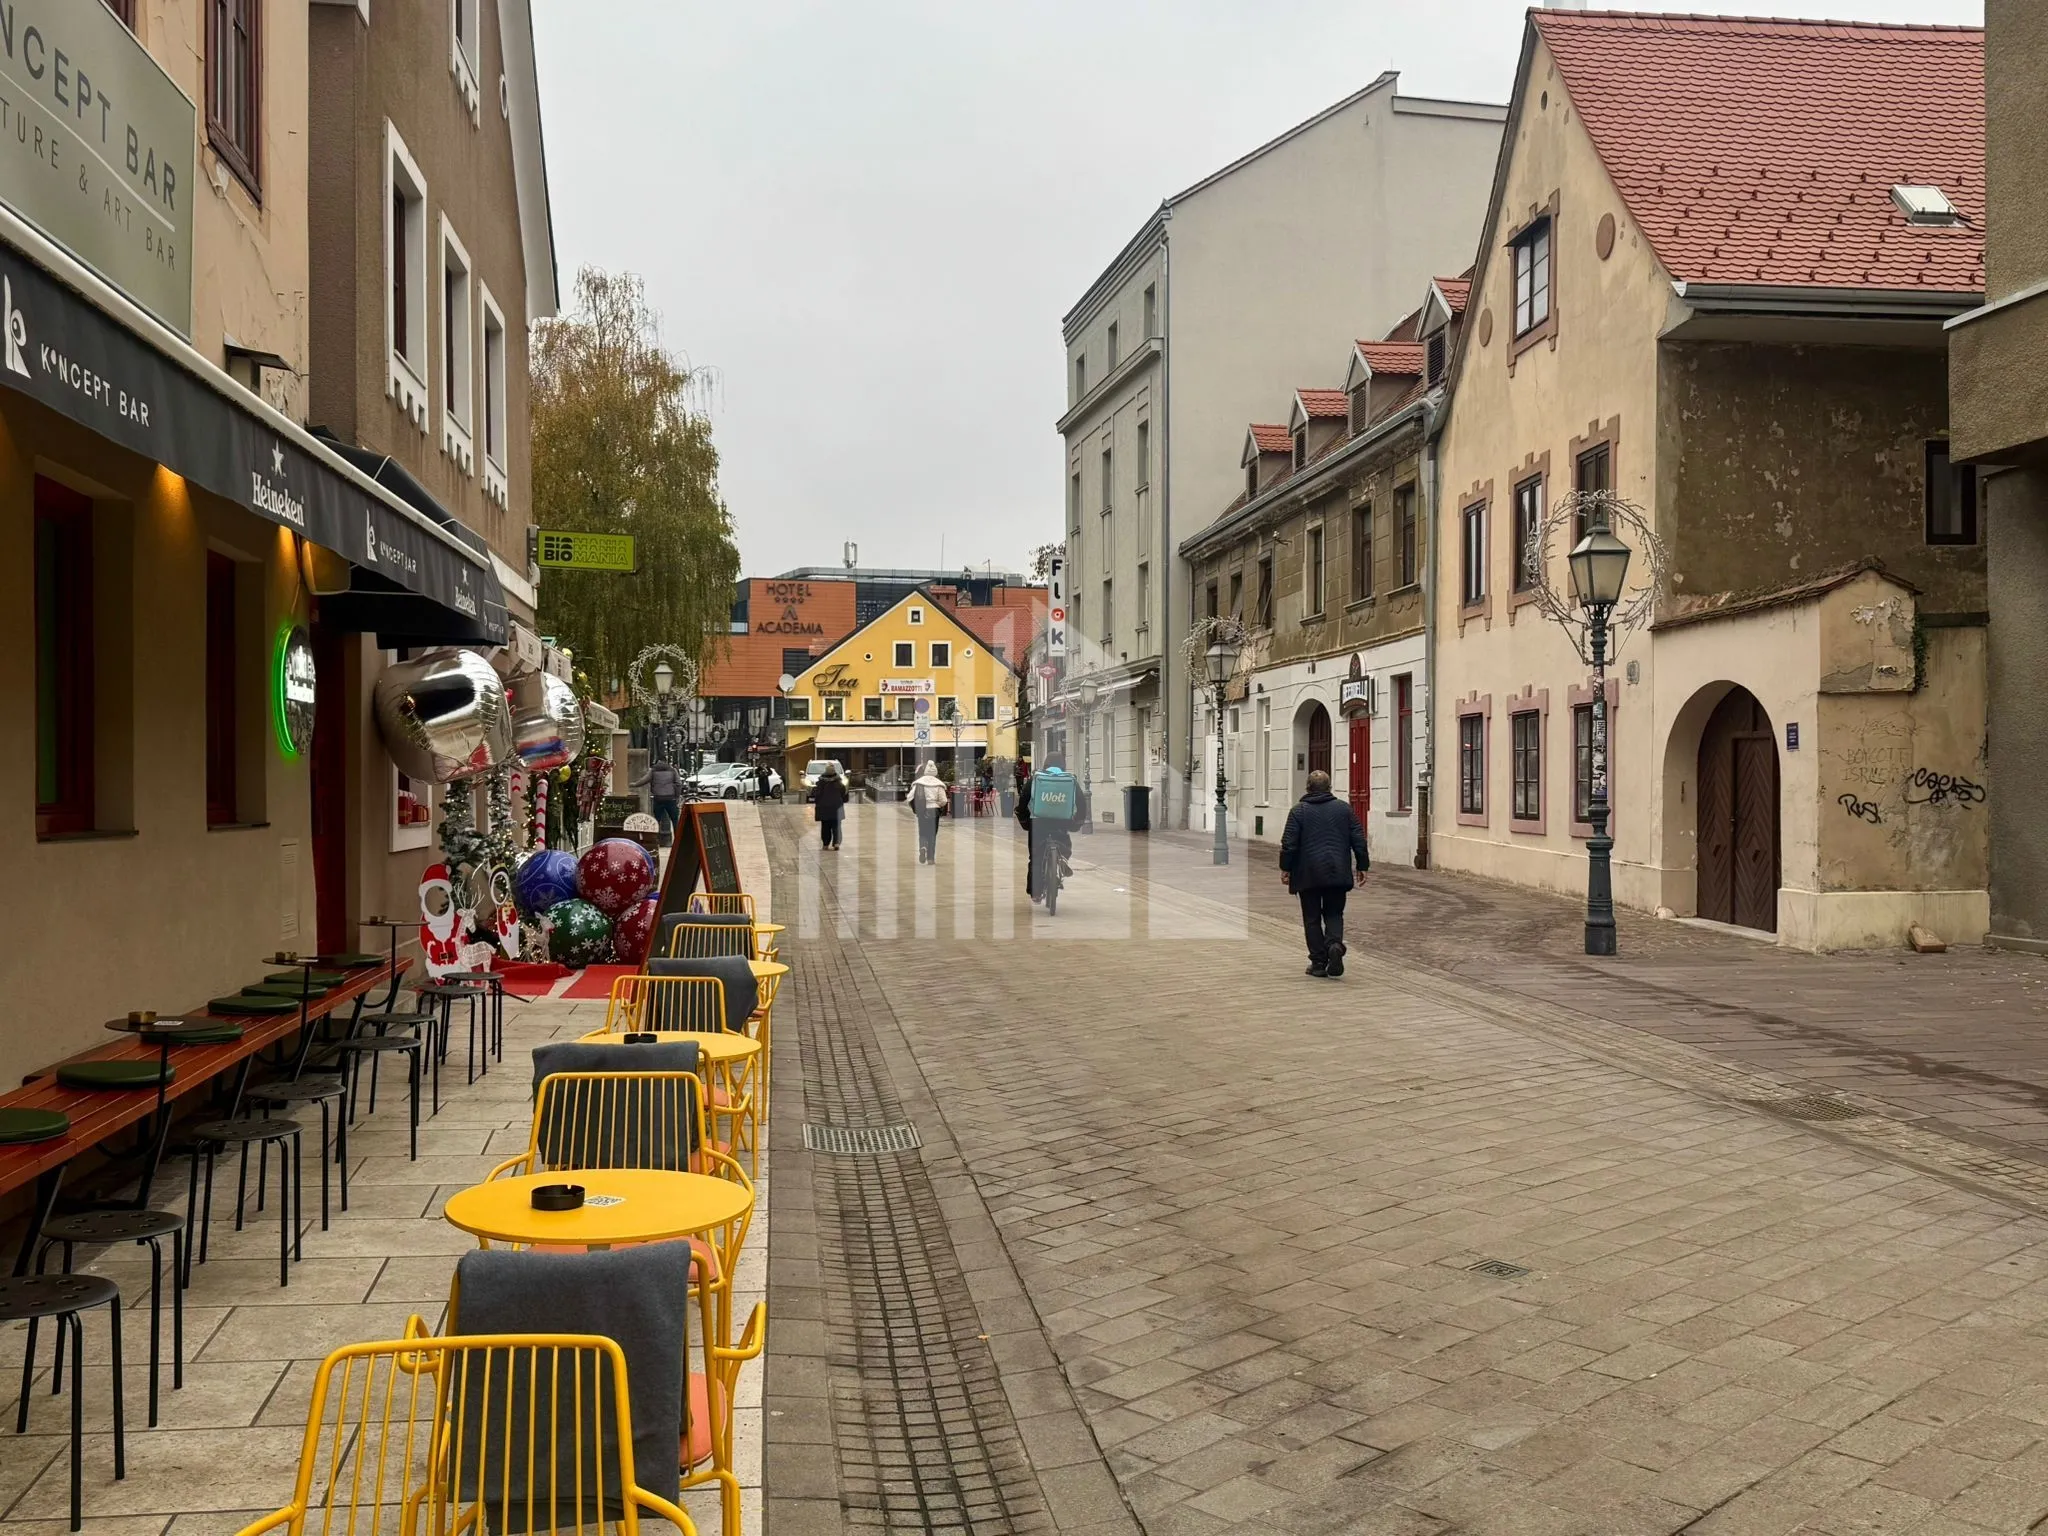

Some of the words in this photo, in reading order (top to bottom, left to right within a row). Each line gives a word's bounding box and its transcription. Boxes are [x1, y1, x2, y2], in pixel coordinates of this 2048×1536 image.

[126, 123, 176, 211] BAR
[0, 96, 58, 169] TURE
[79, 163, 88, 194] &
[103, 187, 132, 233] ART
[146, 226, 175, 271] BAR
[119, 390, 150, 427] BAR
[252, 471, 305, 527] Heineken
[766, 583, 812, 597] HOTEL
[756, 622, 824, 634] ACADEMIA
[812, 663, 860, 689] Tea
[818, 690, 852, 698] FASHION
[1041, 791, 1067, 803] Wolt
